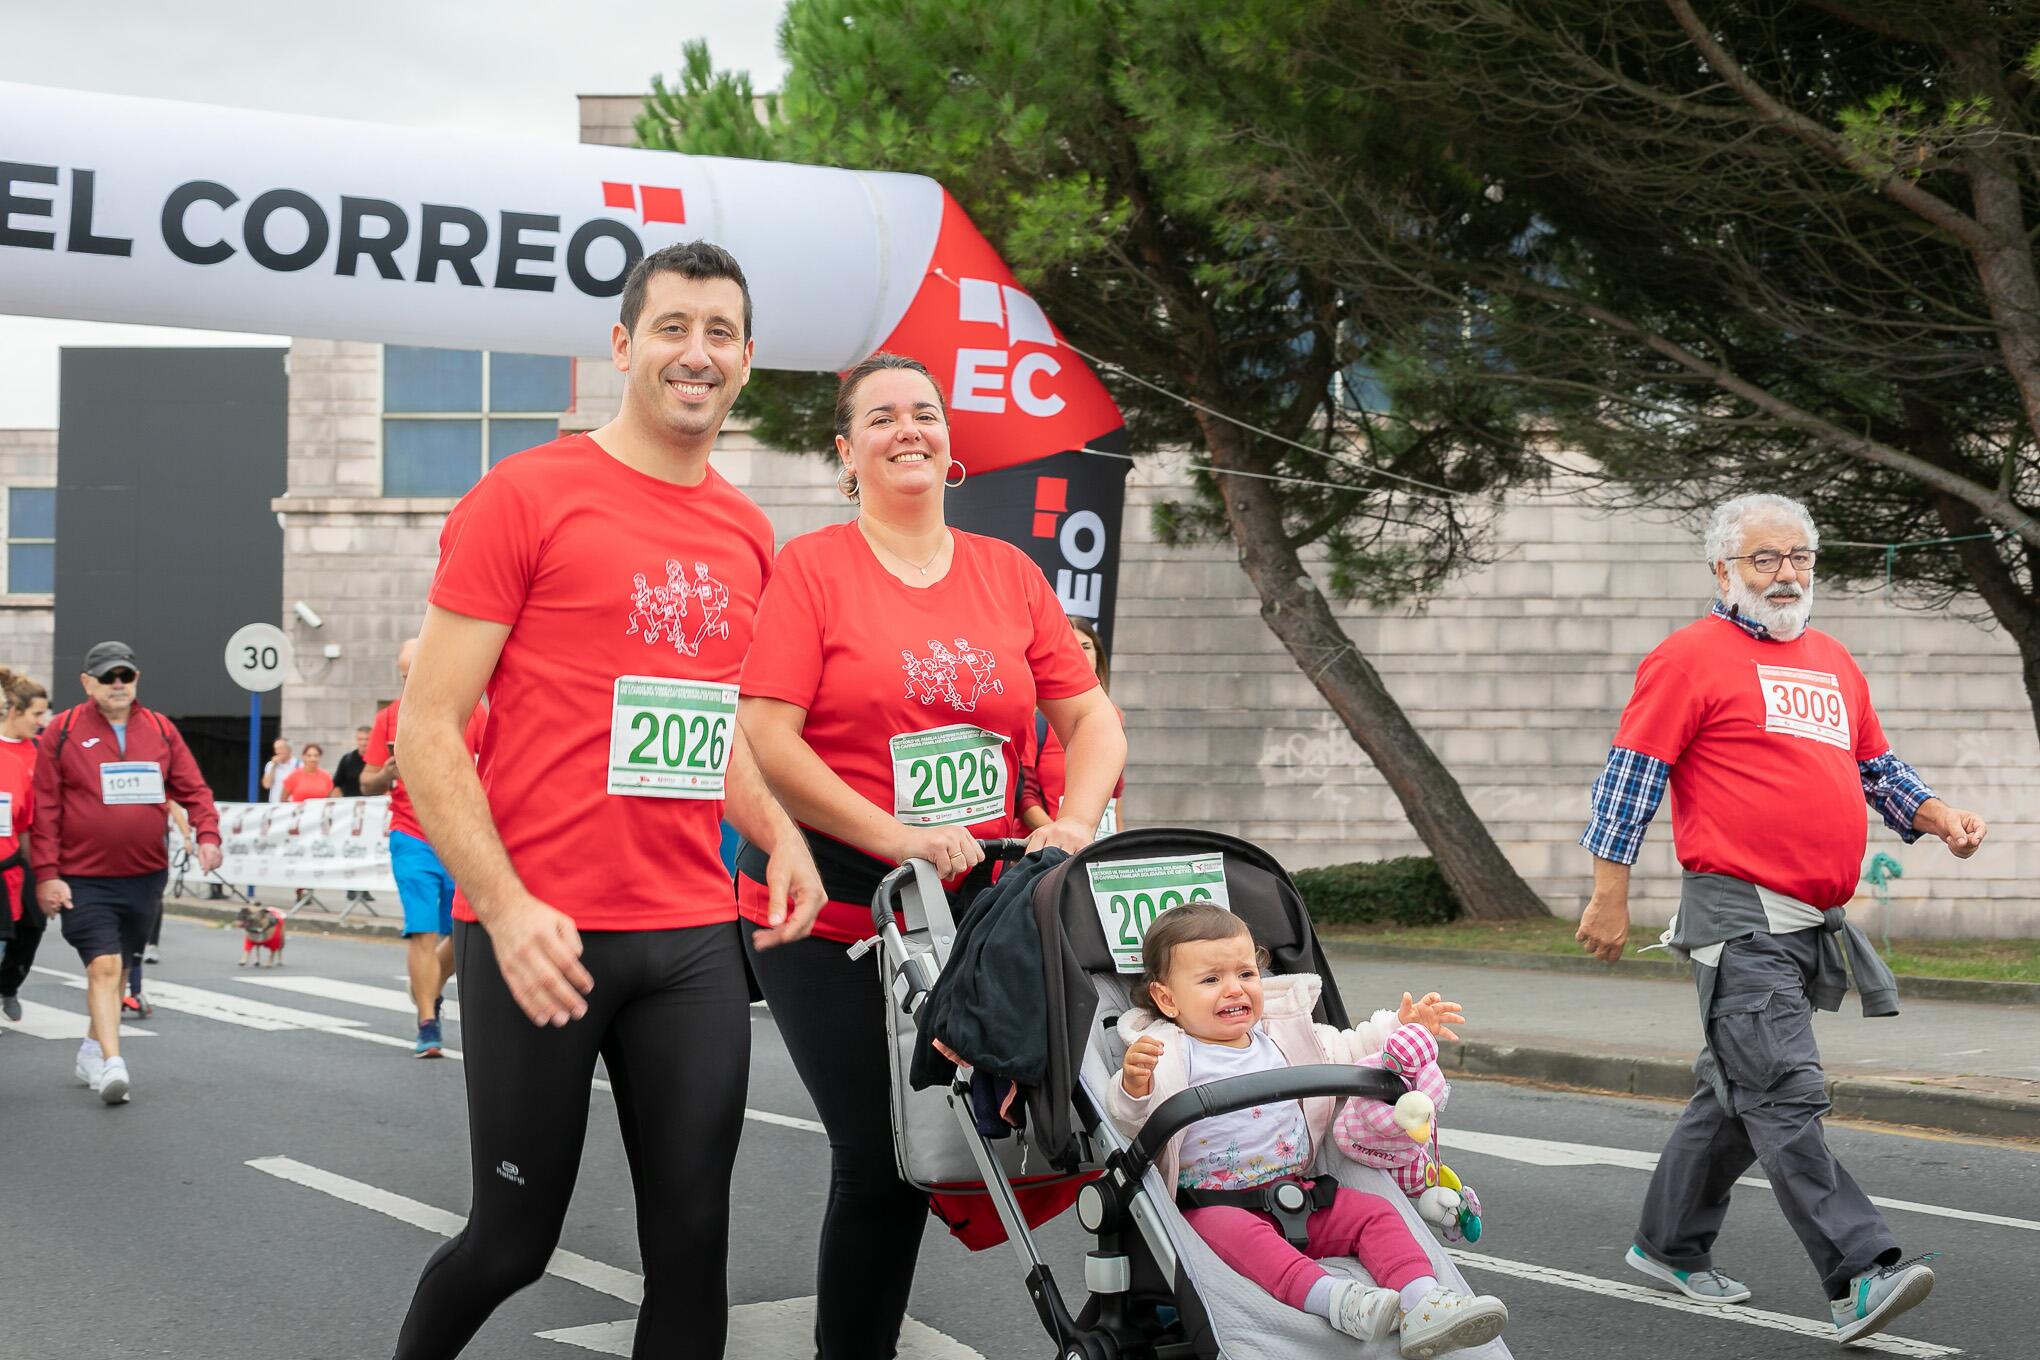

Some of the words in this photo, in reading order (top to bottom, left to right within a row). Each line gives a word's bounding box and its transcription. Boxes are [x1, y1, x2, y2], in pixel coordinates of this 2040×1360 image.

[0, 160, 134, 258] EL
[161, 179, 644, 299] CORREO
[951, 347, 1066, 418] EC
[1056, 509, 1106, 631] EO
[243, 645, 278, 670] 30
[1772, 684, 1840, 727] 3009
[628, 711, 727, 770] 2026
[910, 748, 999, 808] 2026
[1110, 887, 1212, 945] 20
